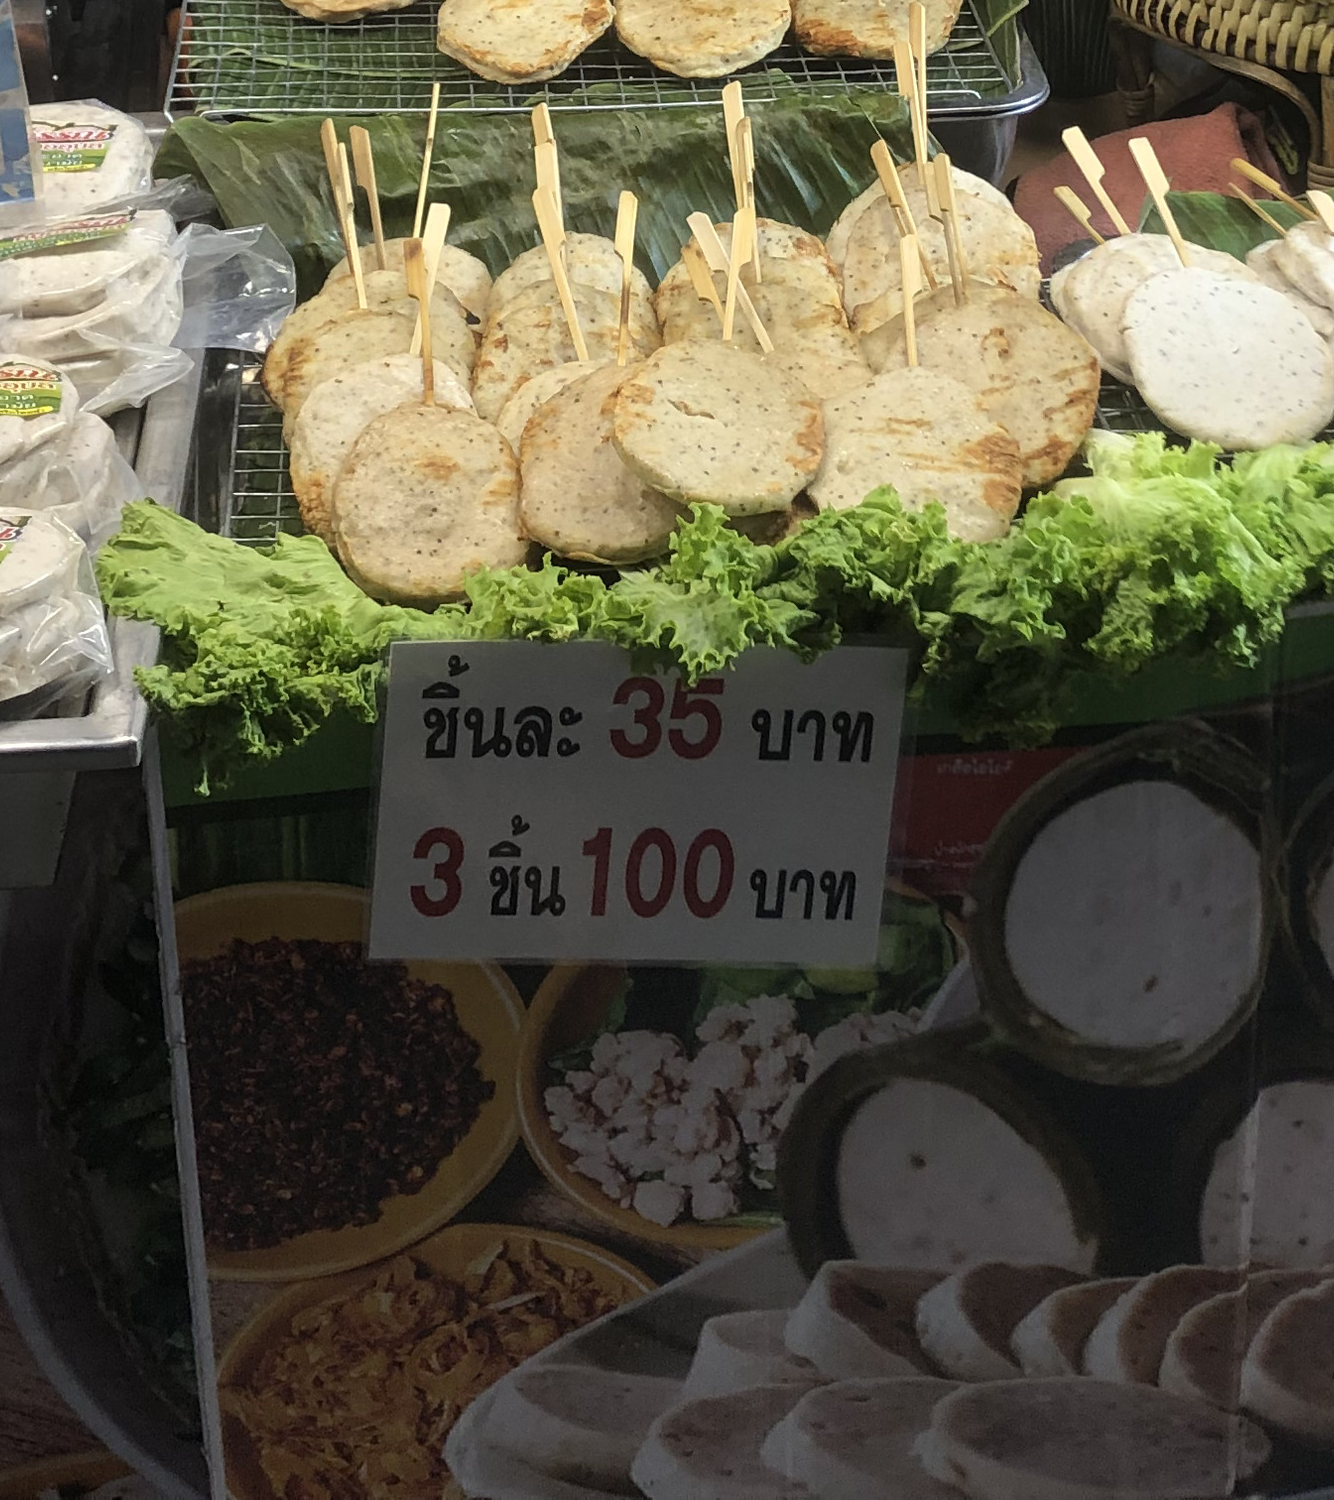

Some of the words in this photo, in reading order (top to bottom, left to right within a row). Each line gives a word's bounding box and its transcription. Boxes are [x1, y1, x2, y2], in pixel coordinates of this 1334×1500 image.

[422, 655, 583, 760] ชิ้นละ
[609, 676, 725, 760] 35
[751, 708, 876, 763] บาท
[409, 827, 466, 918] 3
[488, 815, 566, 917] ชิ้น
[582, 827, 736, 920] 100
[749, 867, 857, 921] บาท
